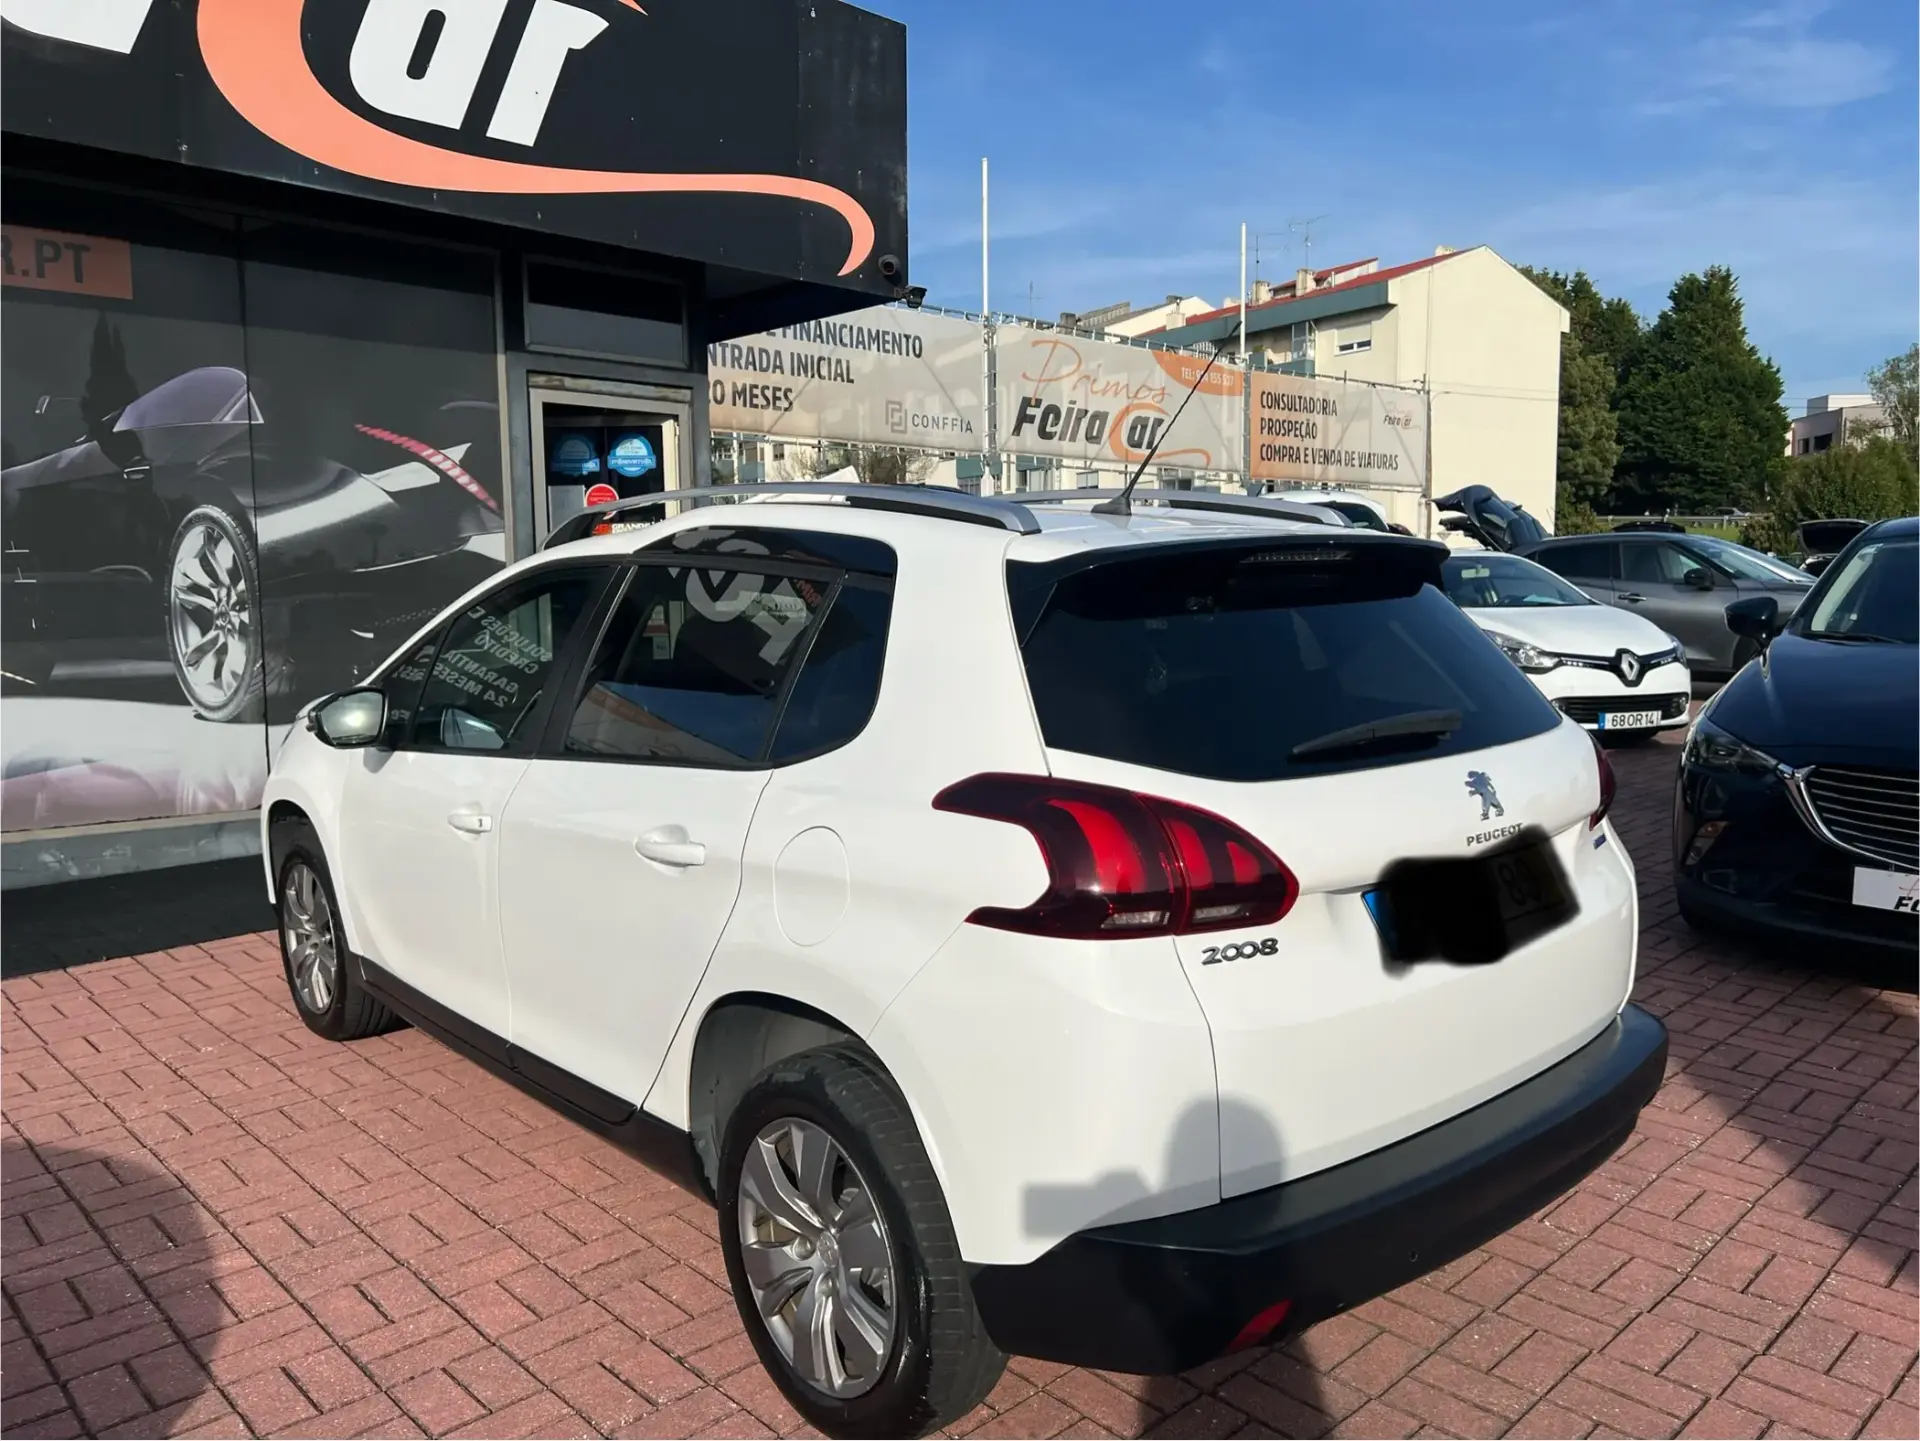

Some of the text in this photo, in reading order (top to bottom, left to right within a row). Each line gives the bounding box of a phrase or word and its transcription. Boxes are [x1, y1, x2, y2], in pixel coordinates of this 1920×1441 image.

[790, 352, 855, 384] INICIAL
[1022, 338, 1173, 405] Primos
[708, 379, 794, 412] 0 MESES
[1260, 391, 1338, 417] CONSULTADORIA
[911, 412, 974, 435] CONFFIA
[1260, 417, 1318, 442] PROSPEÇÃO
[1260, 443, 1399, 471] COMPRA E VENDA DE VIATURAS
[1466, 822, 1524, 847] PEUGEOT
[1201, 937, 1279, 966] 2008
